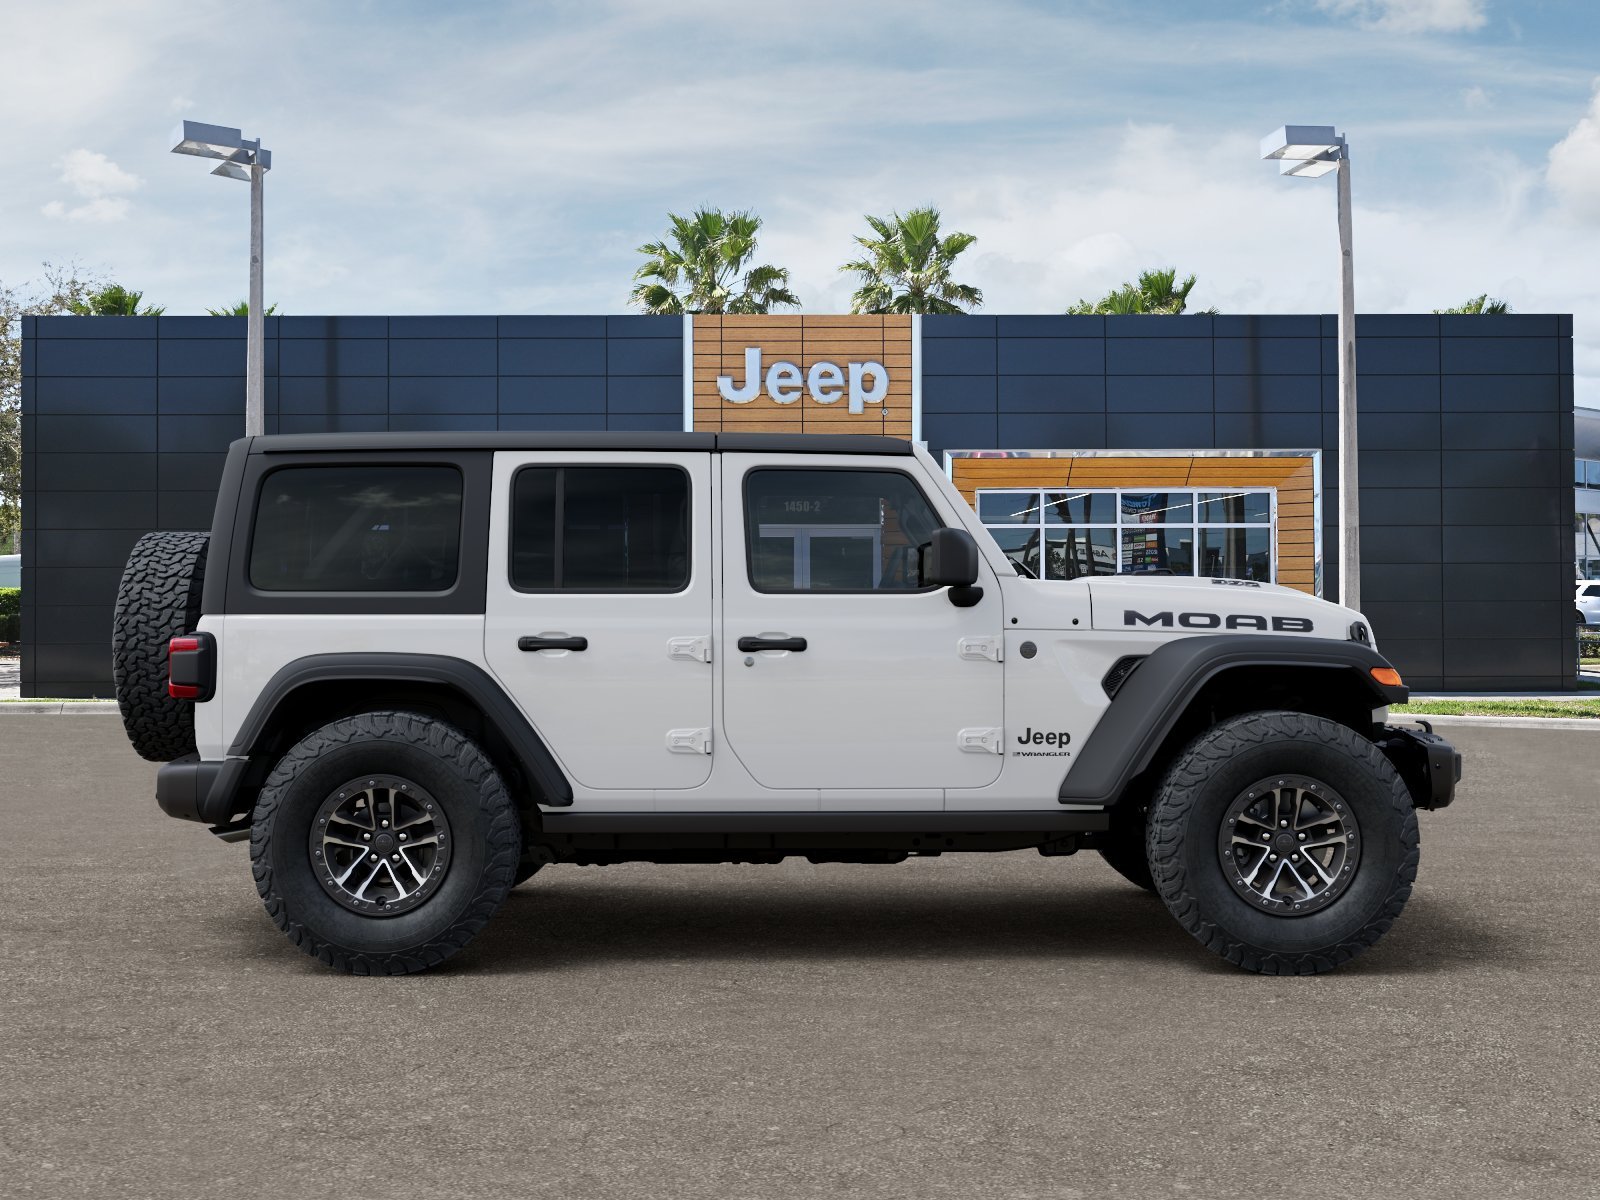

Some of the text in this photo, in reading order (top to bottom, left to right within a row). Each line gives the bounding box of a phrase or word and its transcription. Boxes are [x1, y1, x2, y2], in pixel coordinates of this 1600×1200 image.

[716, 346, 890, 415] Jeep
[784, 500, 821, 512] 1450-2
[1123, 609, 1314, 633] MOAB
[1017, 727, 1071, 749] Jeep
